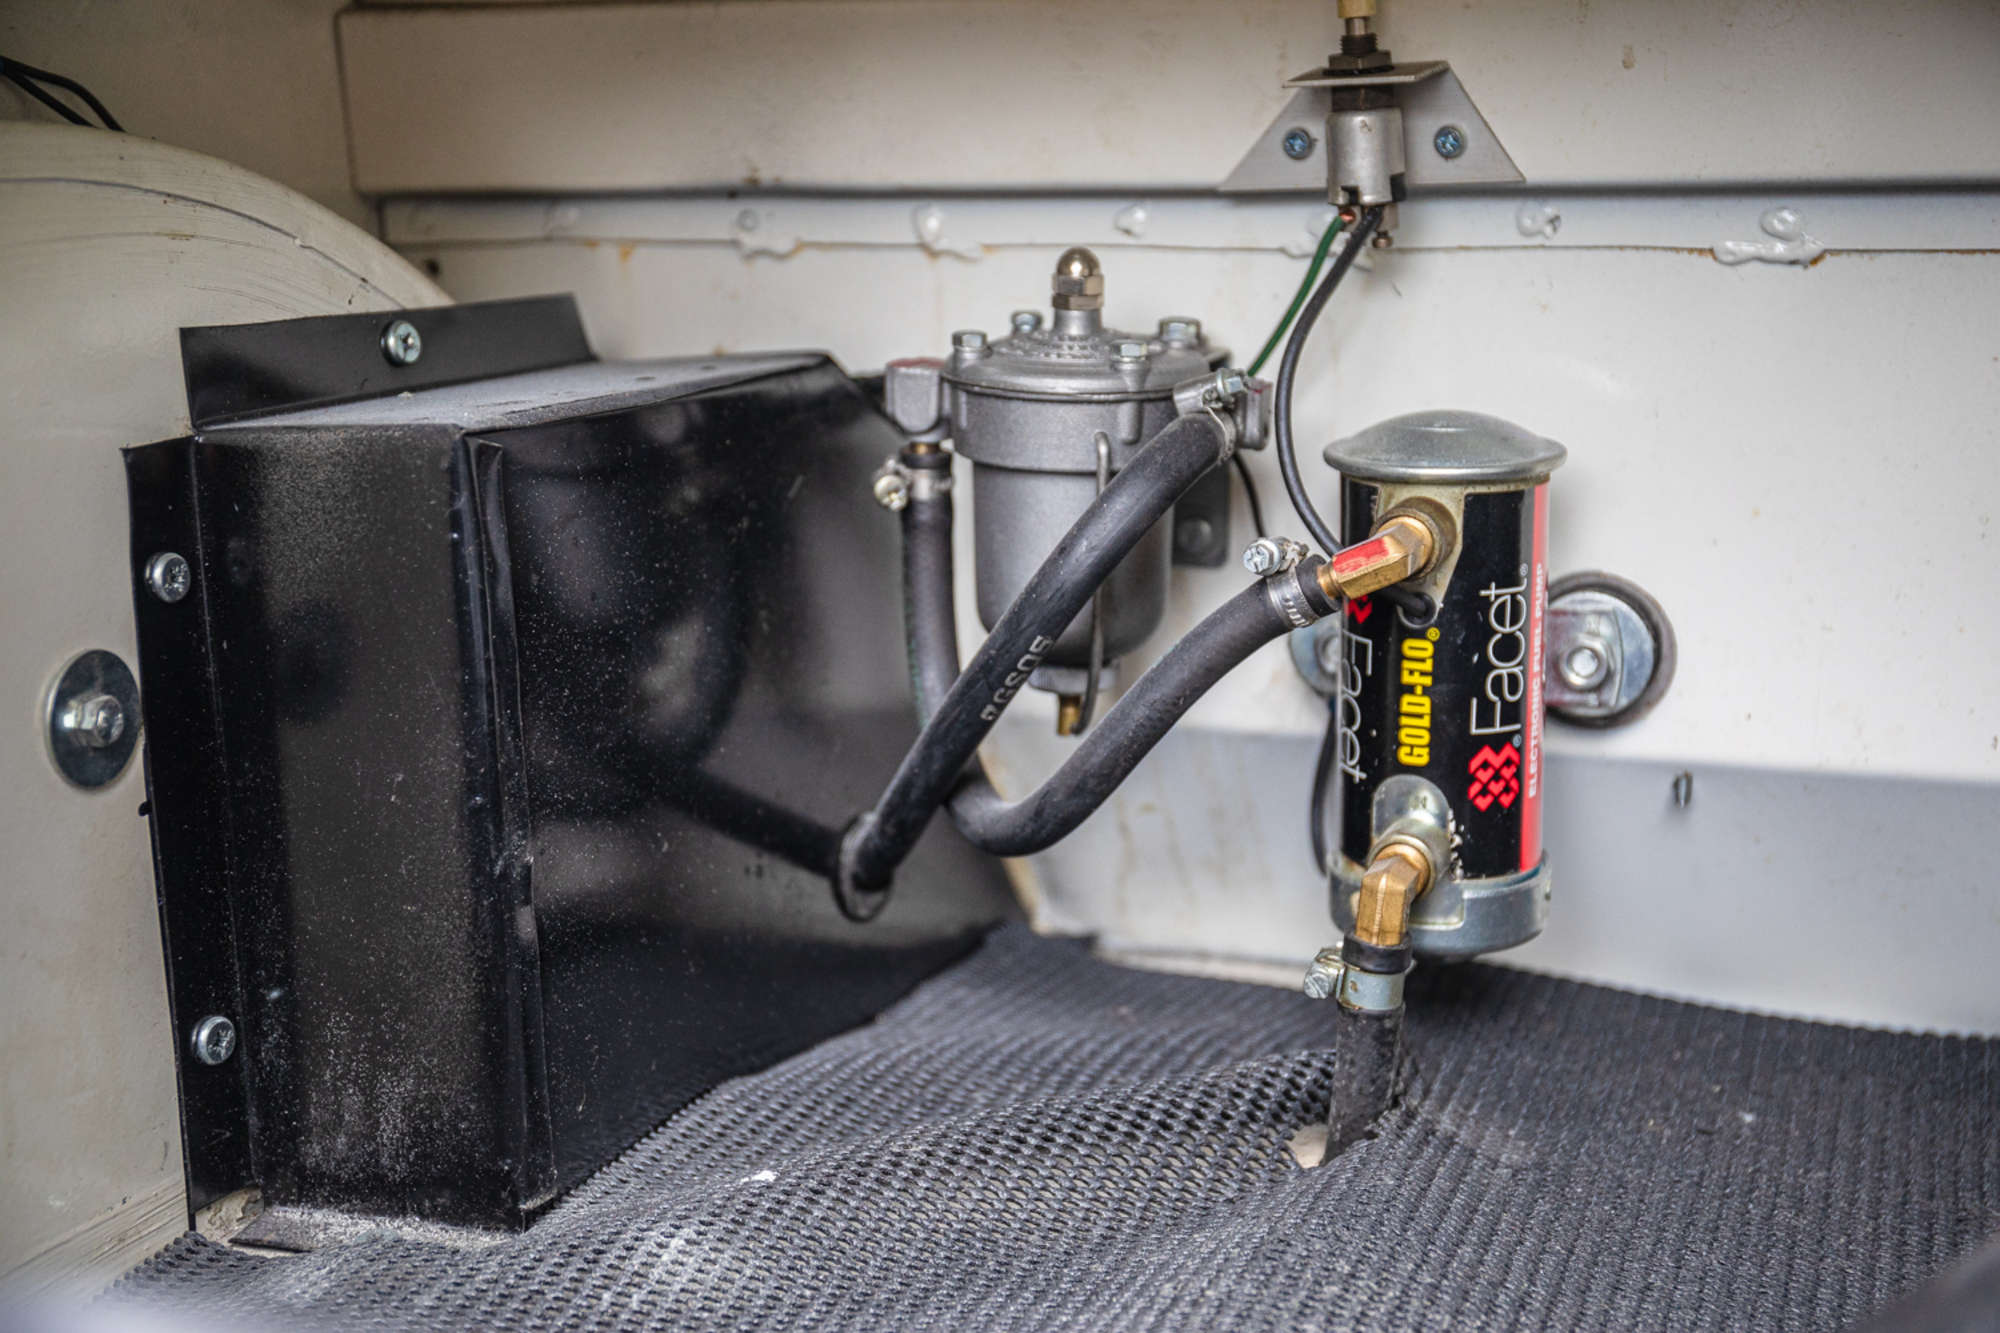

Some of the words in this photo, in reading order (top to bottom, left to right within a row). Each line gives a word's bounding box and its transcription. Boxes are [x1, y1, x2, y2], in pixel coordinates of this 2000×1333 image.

[1535, 562, 1544, 619] PUMP
[1533, 620, 1542, 673] FUEL
[1341, 629, 1373, 783] Facet
[1528, 677, 1541, 798] ELECTRONIC
